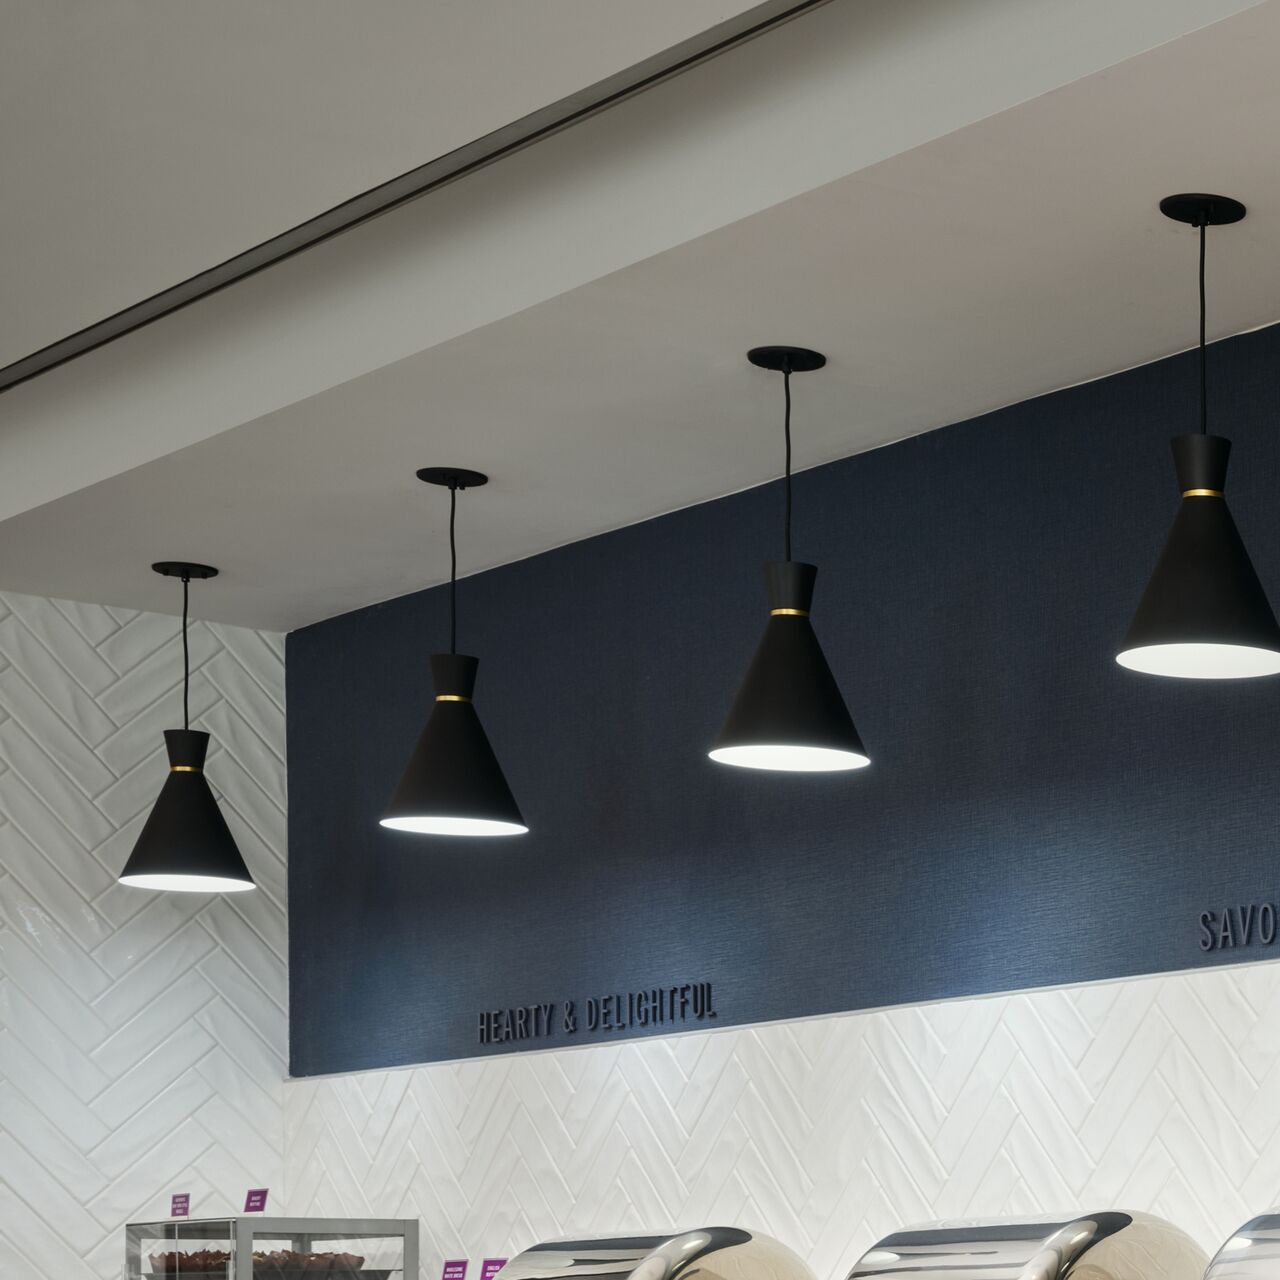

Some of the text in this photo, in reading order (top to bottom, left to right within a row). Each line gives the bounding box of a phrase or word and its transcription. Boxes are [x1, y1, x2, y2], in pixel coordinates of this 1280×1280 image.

[479, 982, 718, 1045] HEARTY & DELIGHTFUL
